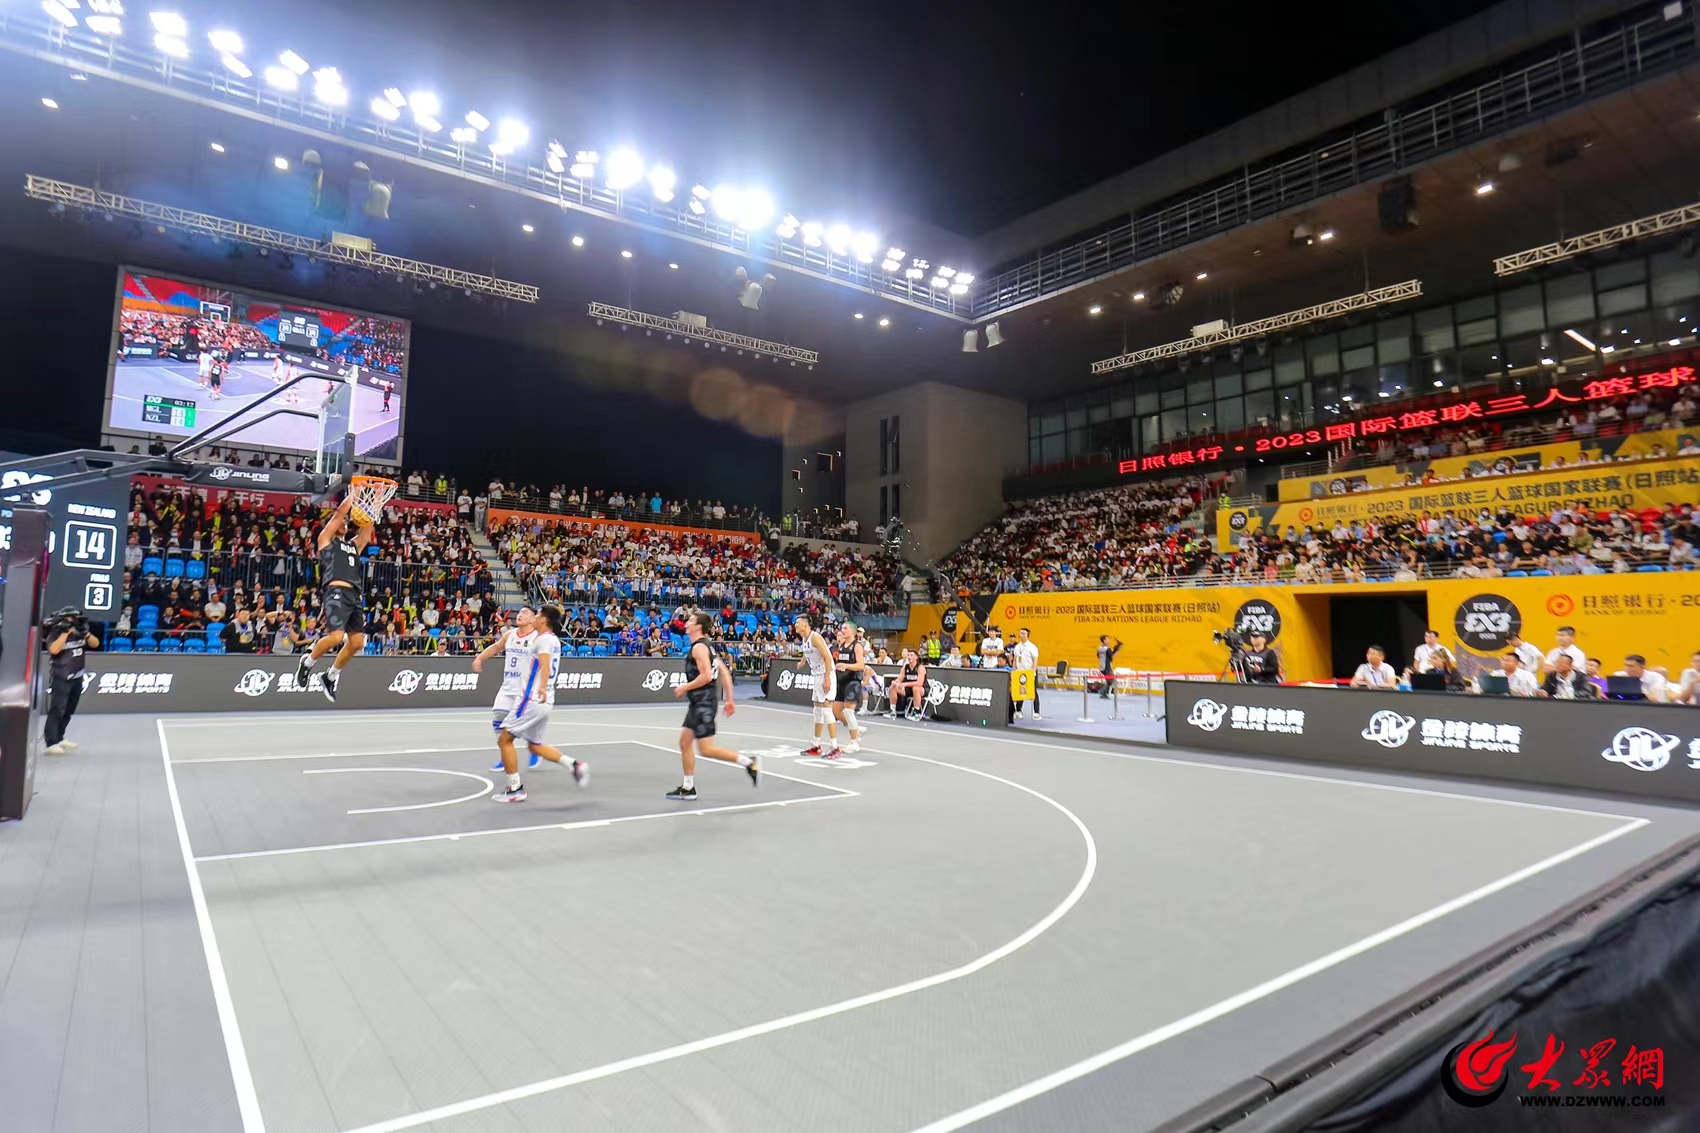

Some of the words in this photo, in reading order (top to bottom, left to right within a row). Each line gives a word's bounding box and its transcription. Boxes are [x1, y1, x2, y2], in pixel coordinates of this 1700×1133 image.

[74, 529, 105, 560] 14
[93, 587, 105, 605] 3
[1247, 605, 1267, 615] FIBA
[1472, 602, 1501, 612] FIBA
[1106, 615, 1139, 623] NATIONS
[1140, 615, 1170, 623] LEAGUE
[1172, 615, 1202, 623] RIZHAO
[510, 656, 518, 668] 9
[1266, 723, 1304, 735] SPORTS
[1468, 740, 1520, 754] SPORTS
